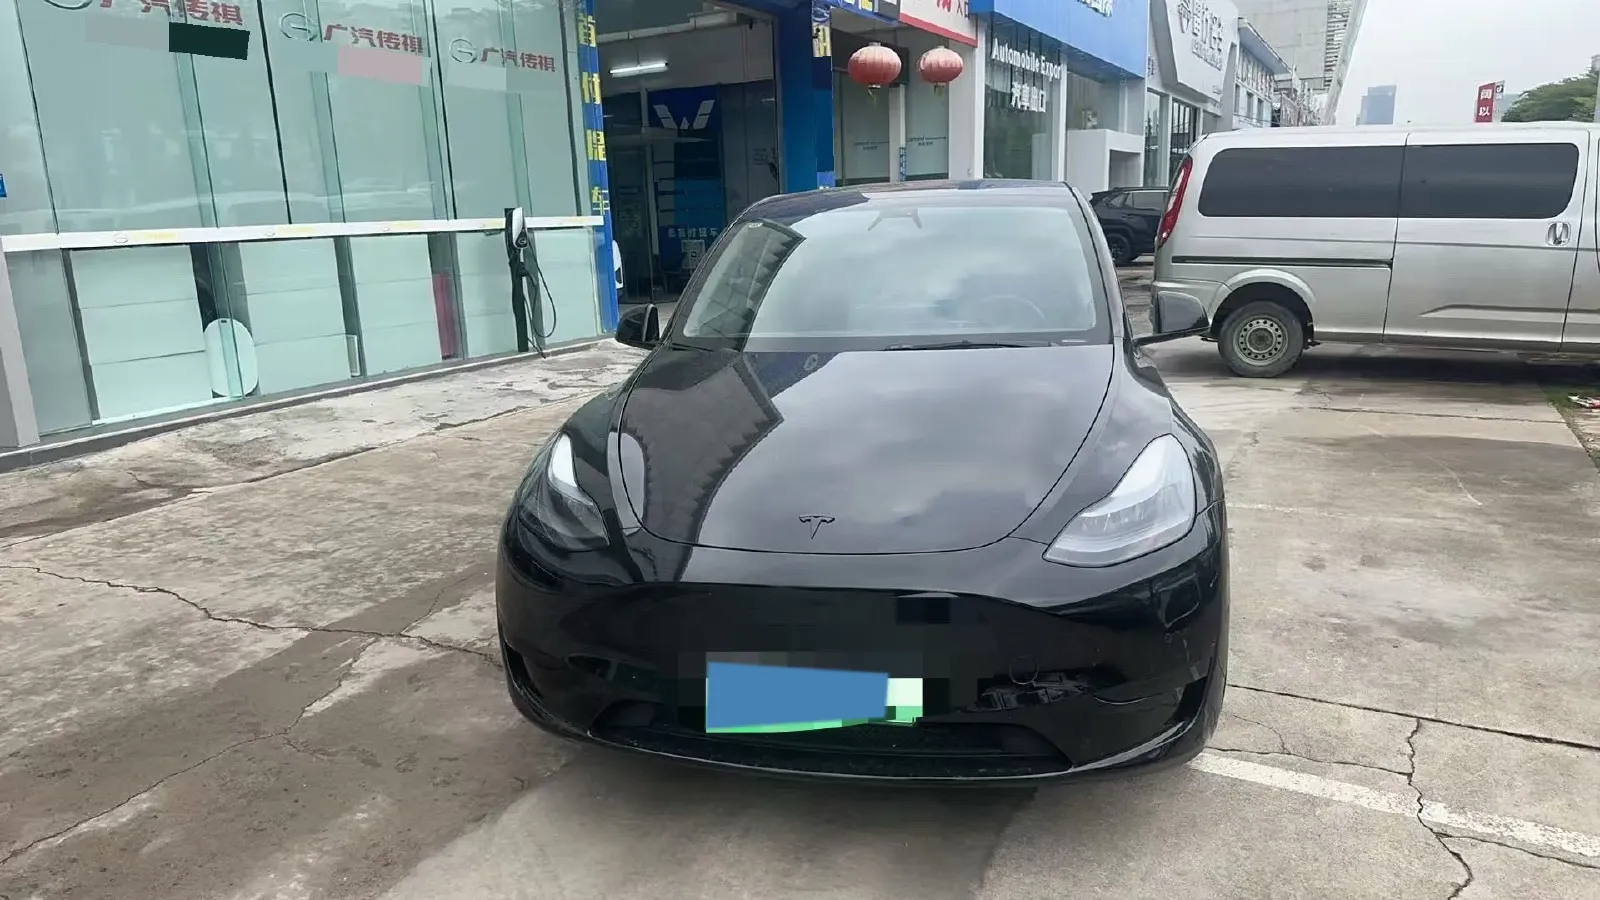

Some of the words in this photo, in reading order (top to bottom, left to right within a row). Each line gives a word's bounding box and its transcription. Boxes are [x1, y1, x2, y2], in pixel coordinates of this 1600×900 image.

[323, 23, 424, 56] 广汽传祺
[991, 37, 1041, 73] Automobile
[480, 46, 556, 73] 广汽传祺
